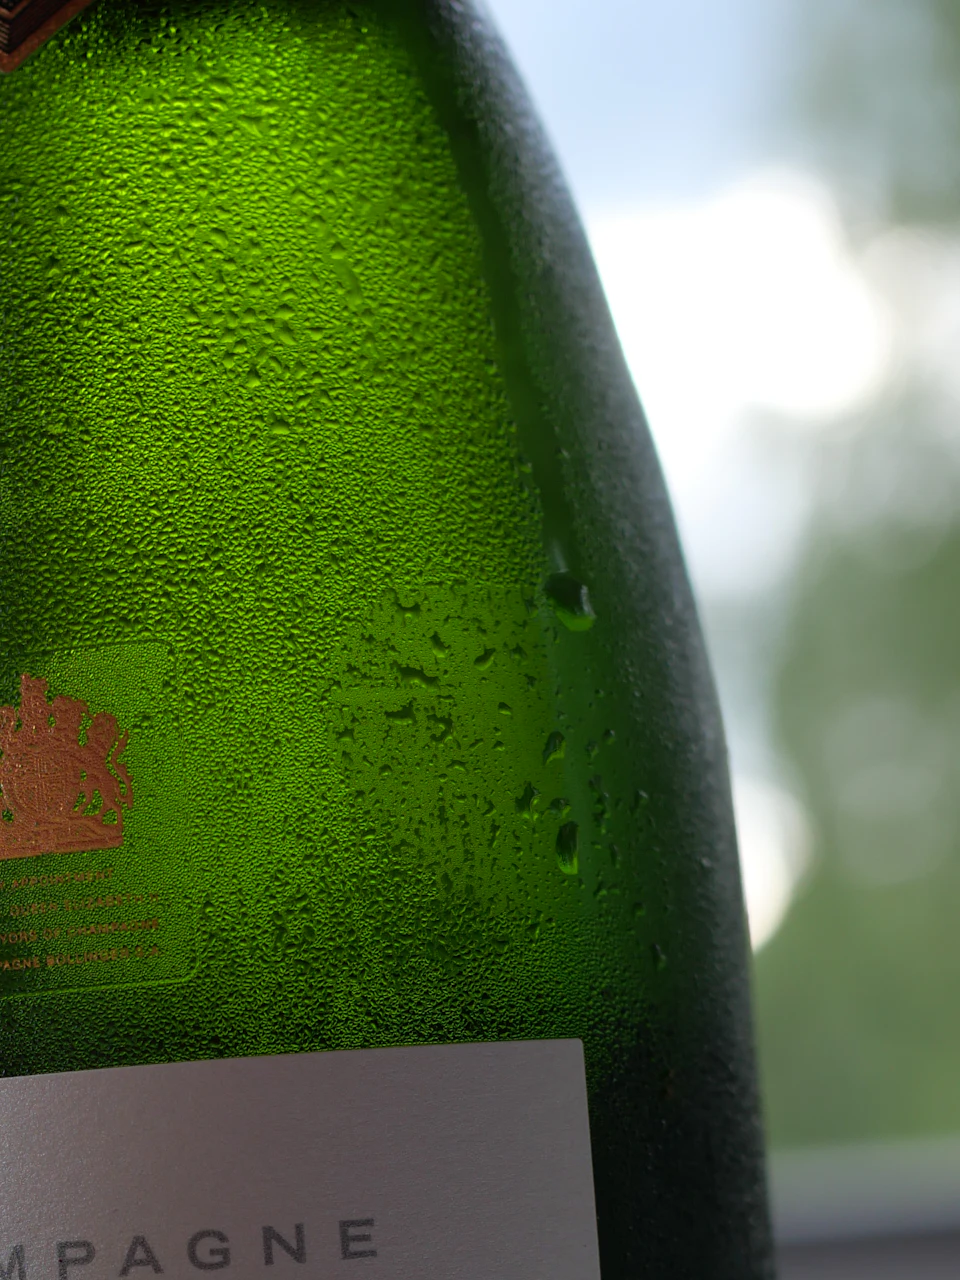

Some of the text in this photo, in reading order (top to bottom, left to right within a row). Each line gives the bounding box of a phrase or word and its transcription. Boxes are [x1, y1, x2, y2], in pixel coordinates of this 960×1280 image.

[12, 868, 113, 888] APPOINTMENT
[43, 926, 62, 941] OF
[46, 946, 130, 967] BOLLINGER
